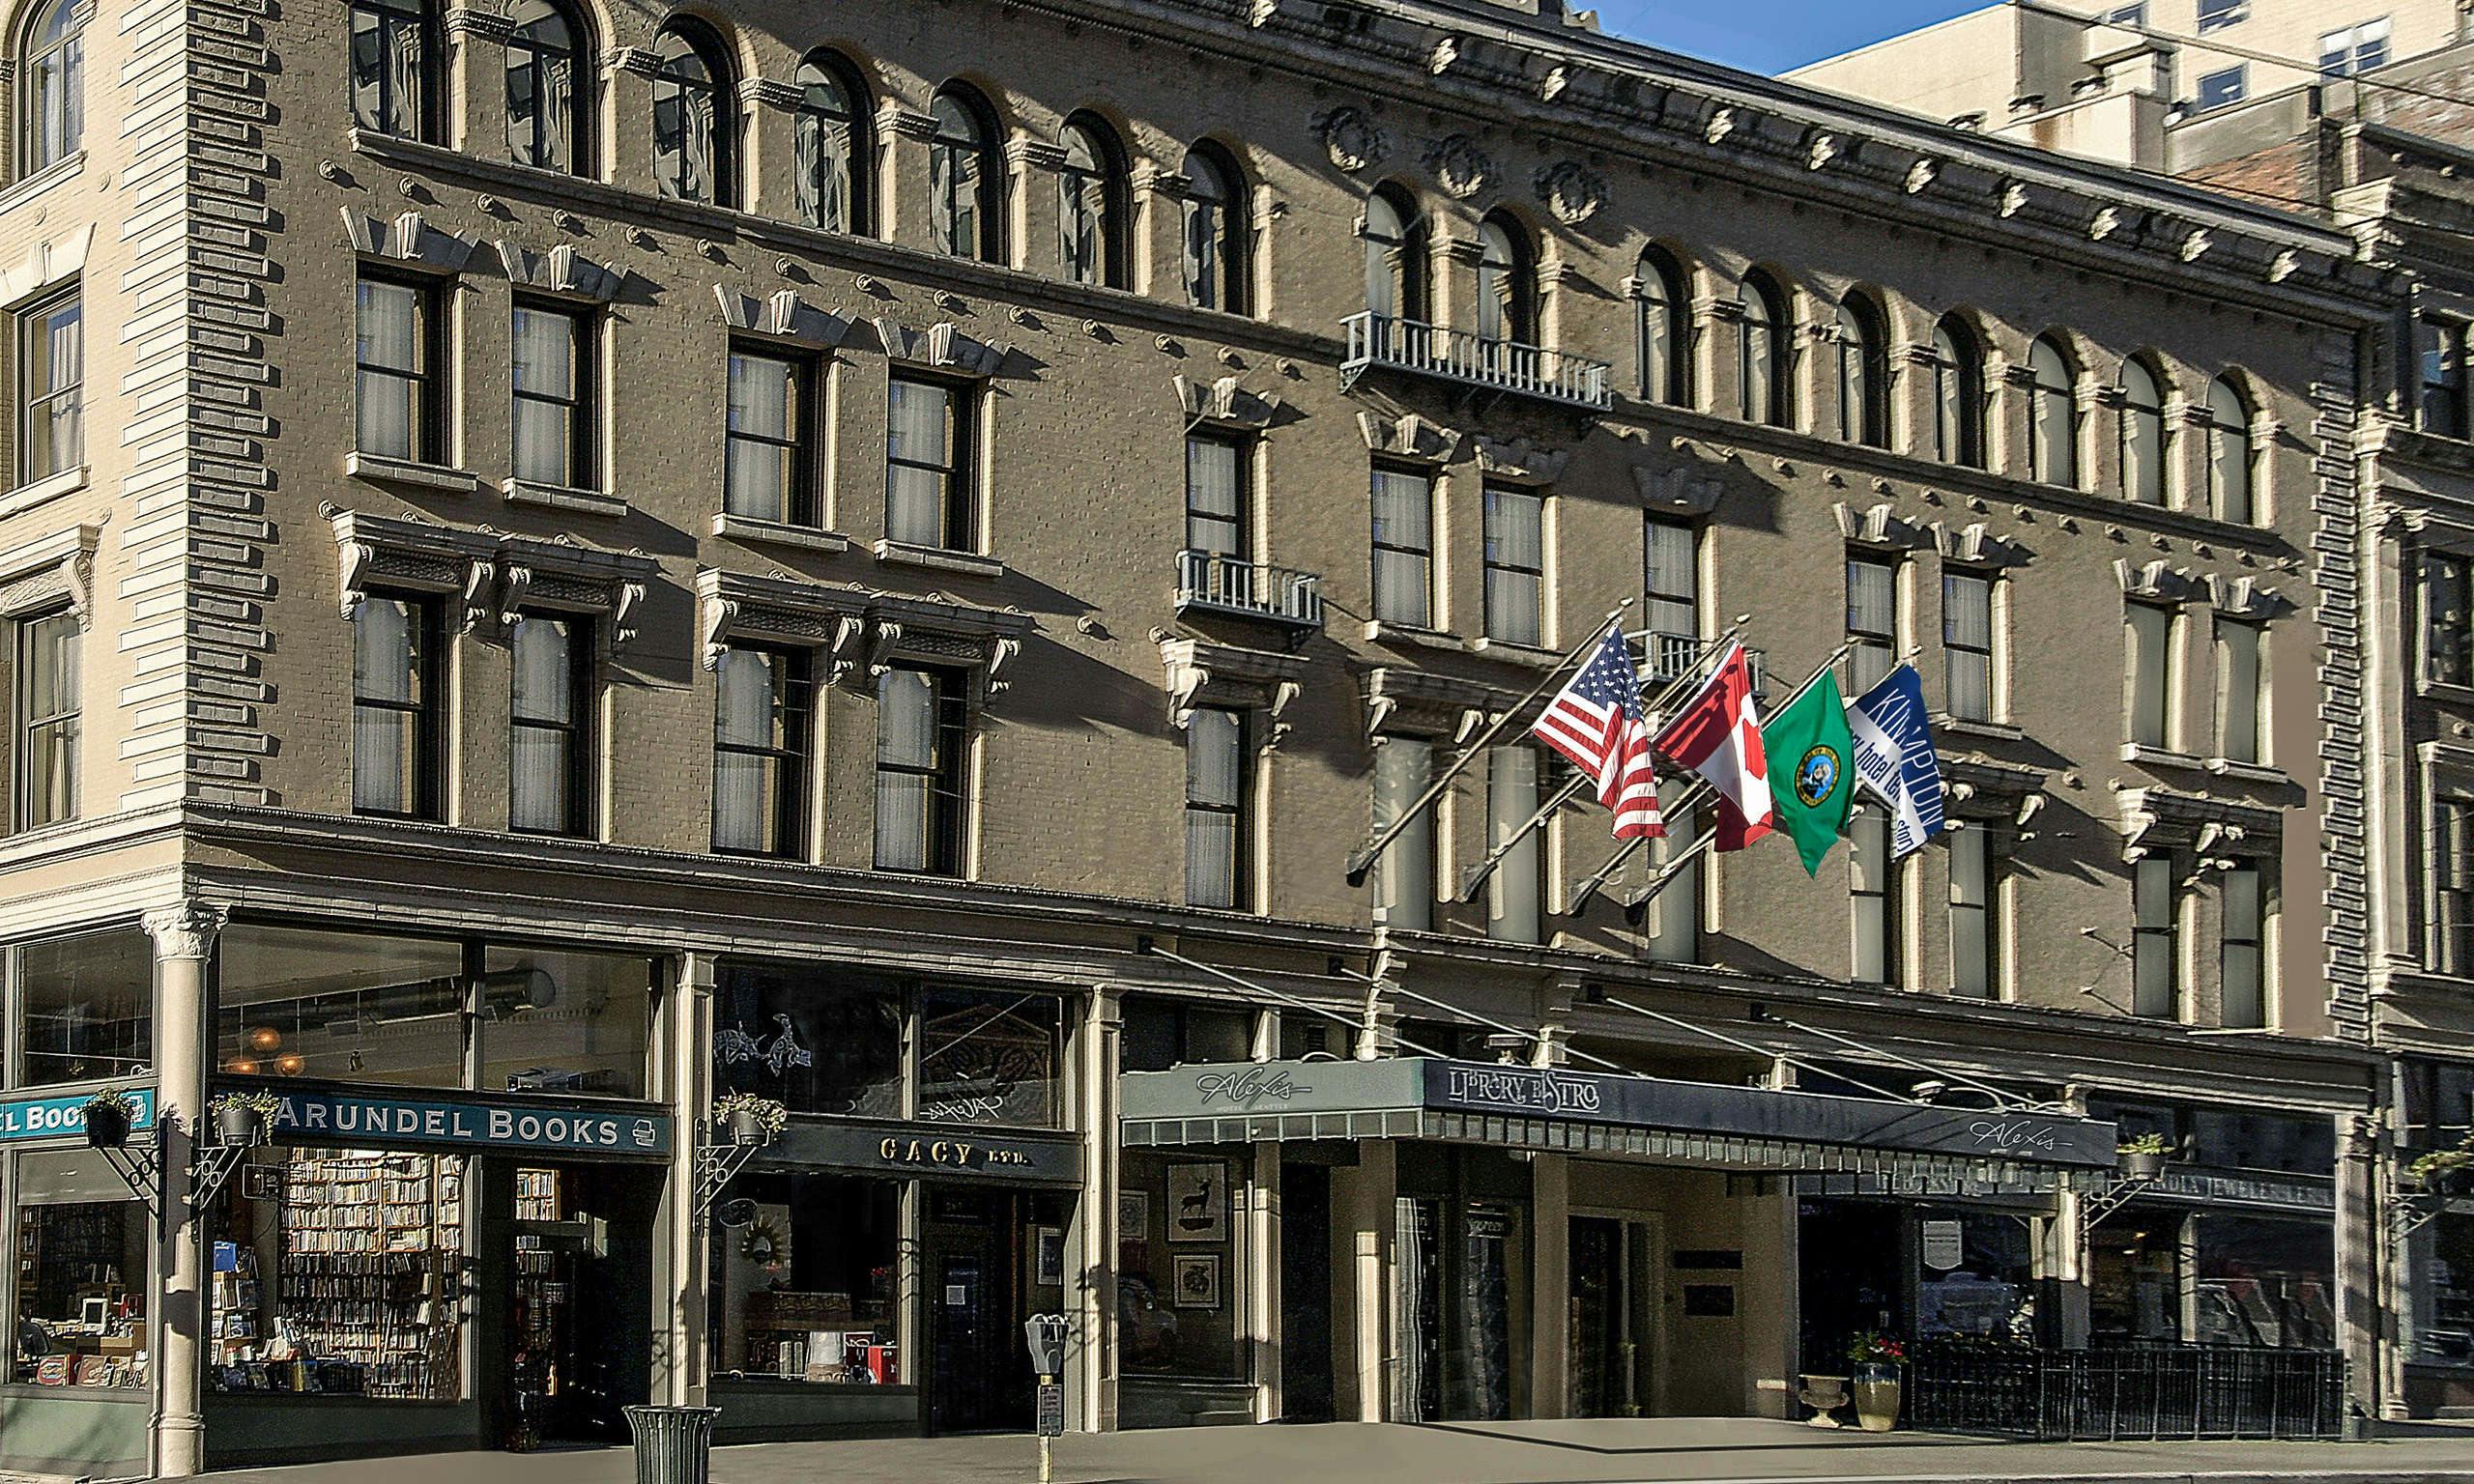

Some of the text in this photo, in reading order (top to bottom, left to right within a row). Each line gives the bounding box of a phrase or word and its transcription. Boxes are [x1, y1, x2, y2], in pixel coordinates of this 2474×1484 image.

[1856, 741, 1896, 785] hotel
[1866, 687, 1943, 828] KIMPTON
[1197, 1067, 1312, 1109] Alexis
[1449, 1069, 1600, 1112] LIBRARY BISTRO
[274, 1097, 618, 1145] ARUNDEL BOOKS
[1970, 1120, 2073, 1152] Alexis
[880, 1137, 972, 1165] GACY
